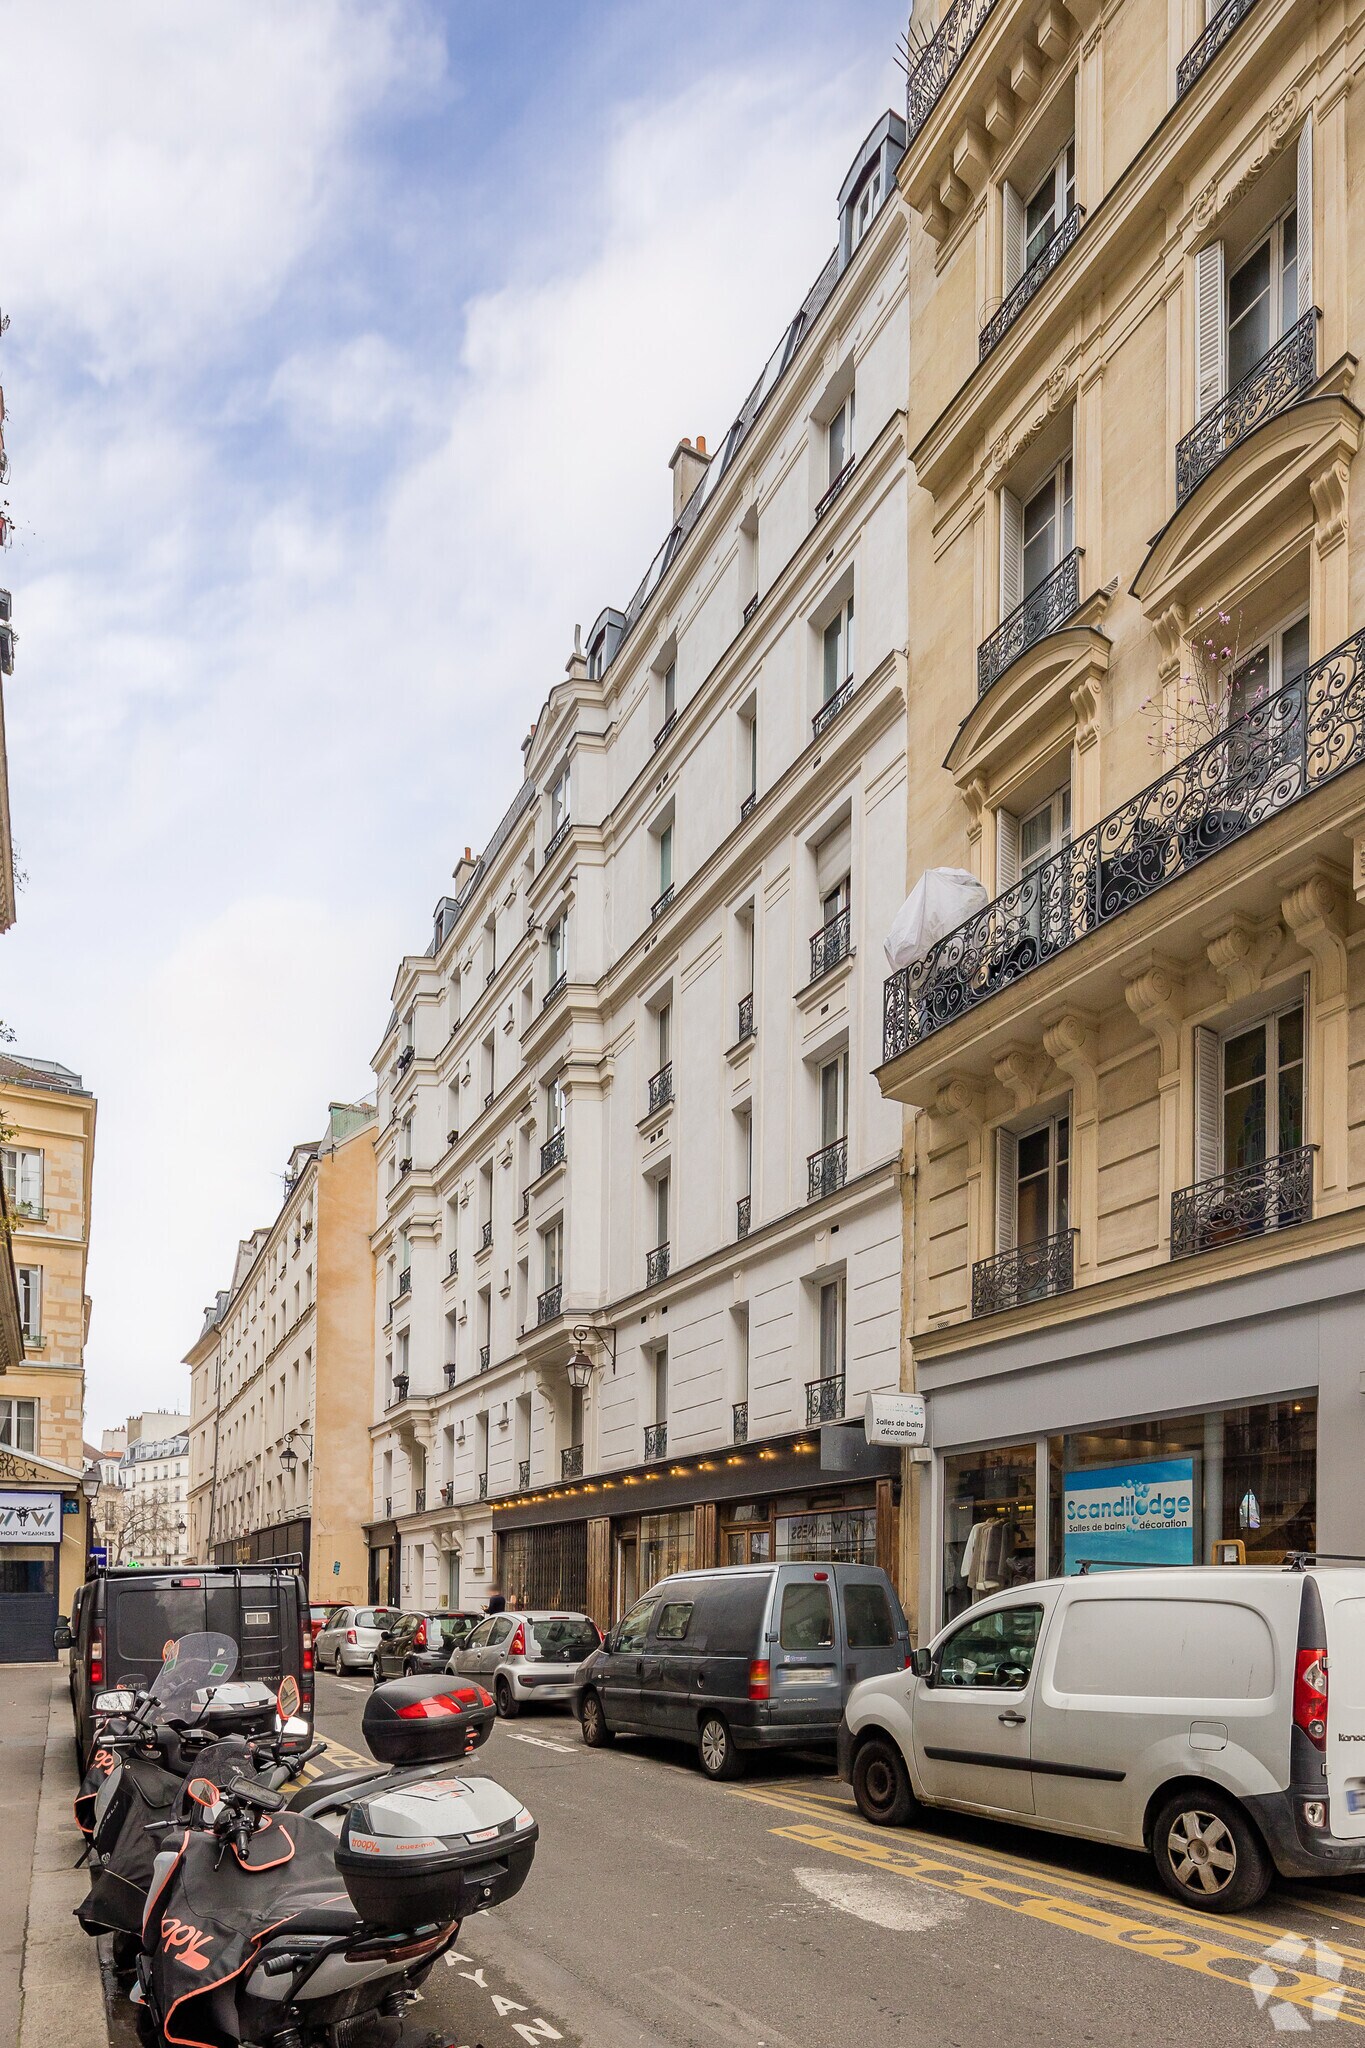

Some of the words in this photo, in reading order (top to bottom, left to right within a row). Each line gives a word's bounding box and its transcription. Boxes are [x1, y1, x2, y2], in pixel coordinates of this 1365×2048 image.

[876, 1418, 895, 1426] Salles
[906, 1421, 924, 1429] bains
[880, 1428, 917, 1437] décoration
[1066, 1493, 1191, 1520] Scandilodge
[1068, 1524, 1091, 1533] Salles
[1091, 1523, 1103, 1532] de
[1104, 1522, 1126, 1531] bains
[1139, 1519, 1187, 1530] décoration
[351, 1837, 380, 1852] troopy
[395, 1841, 435, 1850] Louez-moi
